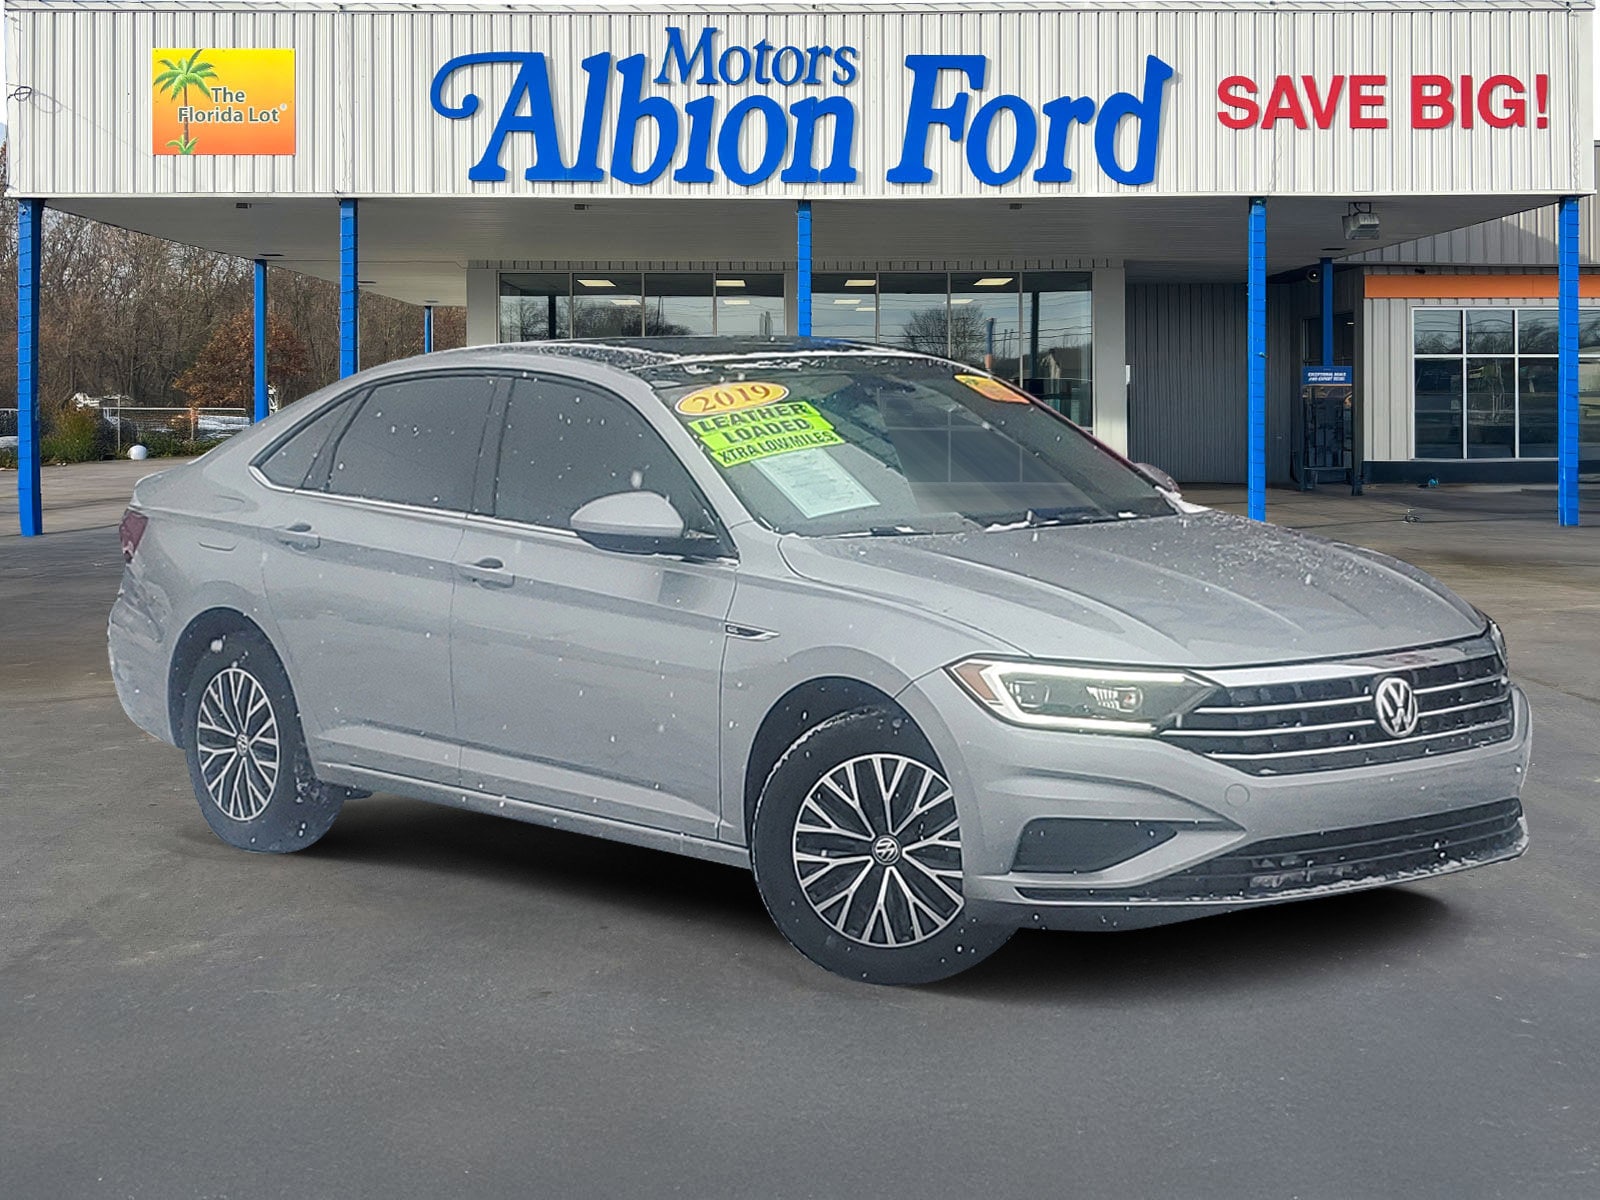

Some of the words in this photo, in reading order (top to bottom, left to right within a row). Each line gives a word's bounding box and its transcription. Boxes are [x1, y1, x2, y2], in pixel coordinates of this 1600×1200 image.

[654, 27, 857, 86] Motors
[210, 86, 246, 103] The
[1217, 75, 1388, 129] SAVE
[1411, 75, 1548, 129] BIG!
[177, 106, 244, 123] Florida
[248, 107, 280, 123] Lot
[430, 52, 858, 186] Albion
[886, 54, 1175, 186] Ford
[693, 384, 771, 412] 2019
[699, 403, 808, 432] LEATHER
[723, 418, 813, 444] LOADED
[717, 446, 758, 464] XTRA
